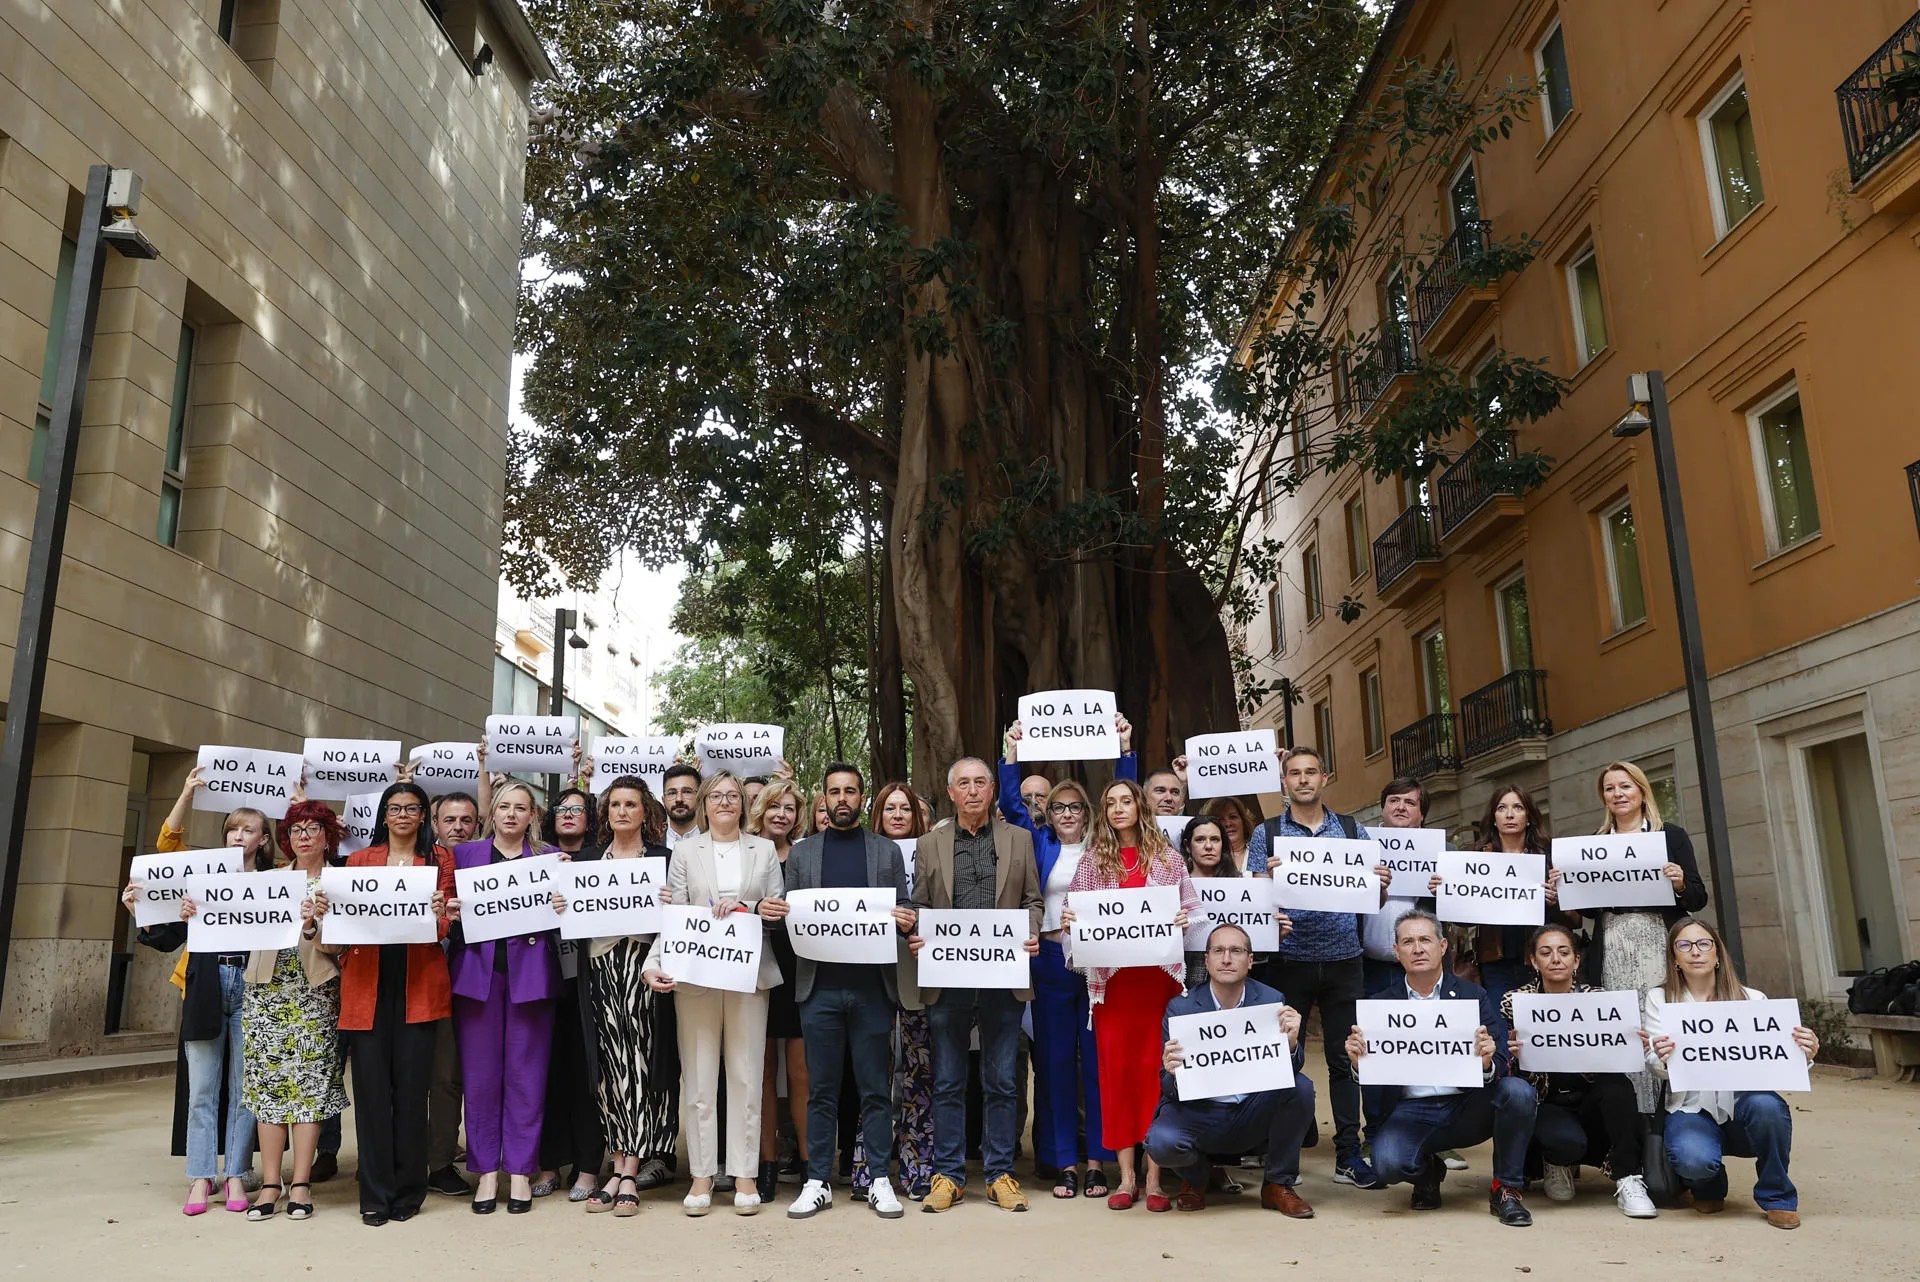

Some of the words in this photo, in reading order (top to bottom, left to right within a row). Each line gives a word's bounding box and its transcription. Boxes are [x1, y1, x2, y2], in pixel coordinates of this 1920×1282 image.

[1032, 704, 1055, 716] NO
[1062, 703, 1073, 715] A
[1084, 702, 1103, 715] LA
[499, 724, 520, 735] NO
[526, 725, 536, 736] A
[545, 726, 562, 737] LA
[707, 732, 728, 741] NO
[734, 731, 743, 740] A
[753, 730, 770, 739] LA
[1029, 724, 1106, 738] CENSURA
[433, 750, 454, 760] NO
[465, 751, 475, 761] A
[496, 743, 563, 755] CENSURA
[604, 745, 625, 754] NO
[630, 745, 639, 755] A
[649, 745, 665, 755] LA
[706, 746, 772, 760] CENSURA
[1198, 745, 1220, 757] NO
[1227, 744, 1237, 754] A
[1246, 741, 1264, 752] LA
[323, 751, 346, 762] NO
[349, 752, 359, 763] A
[363, 752, 381, 764] LA
[213, 759, 238, 771] NO
[245, 761, 256, 773] A
[267, 764, 286, 777] LA
[601, 763, 666, 774] CENSURA
[1198, 761, 1268, 777] CENSURA
[315, 770, 388, 782] CENSURA
[207, 780, 286, 798] CENSURA
[352, 806, 372, 818] NO
[1378, 838, 1401, 850] NO
[1405, 839, 1415, 851] A
[1290, 850, 1315, 863] NO
[1323, 851, 1333, 864] A
[1345, 853, 1364, 866] LA
[1581, 847, 1608, 861] NO
[1624, 846, 1637, 859] A
[148, 866, 174, 880] NO
[183, 865, 193, 878] A
[1380, 859, 1437, 873] PACITAT
[1465, 862, 1490, 875] NO
[1505, 865, 1516, 877] A
[473, 878, 499, 893] NO
[507, 874, 518, 887] A
[529, 869, 550, 883] LA
[575, 875, 600, 889] NO
[608, 873, 619, 886] A
[631, 871, 651, 885] LA
[1287, 872, 1367, 888] CENSURA
[1563, 868, 1661, 884] L'OPACITAT
[352, 879, 378, 892] NO
[395, 879, 406, 892] A
[1445, 883, 1537, 900] L'OPACITAT
[147, 888, 188, 901] CEN
[206, 888, 233, 902] NO
[242, 887, 254, 900] A
[268, 886, 290, 899] LA
[1201, 889, 1226, 902] NO
[1241, 890, 1251, 902] A
[332, 902, 428, 917] L'OPACITAT
[474, 891, 553, 916] CENSURA
[573, 895, 654, 913] CENSURA
[814, 899, 840, 912] NO
[856, 899, 867, 912] A
[1098, 902, 1124, 916] NO
[1140, 900, 1152, 913] A
[203, 910, 293, 926] CENSURA
[1207, 912, 1272, 925] PACITAT
[685, 918, 710, 933] NO
[725, 924, 736, 937] A
[794, 922, 888, 936] L'OPACITAT
[936, 923, 961, 936] NO
[969, 924, 981, 937] A
[993, 924, 1014, 937] LA
[1079, 923, 1174, 941] L'OPACITAT
[664, 941, 754, 964] L'OPACITAT
[932, 947, 1016, 961] CENSURA
[1388, 1014, 1416, 1028] NO
[1435, 1014, 1448, 1028] A
[1532, 1009, 1561, 1023] NO
[1571, 1008, 1584, 1022] A
[1597, 1007, 1622, 1021] LA
[1199, 1024, 1227, 1040] NO
[1244, 1020, 1256, 1035] A
[1682, 1019, 1714, 1034] NO
[1725, 1018, 1739, 1033] A
[1753, 1017, 1780, 1032] LA
[1367, 1040, 1473, 1055] L'OPACITAT
[1531, 1033, 1627, 1047] CENSURA
[1682, 1045, 1789, 1062] CENSURA
